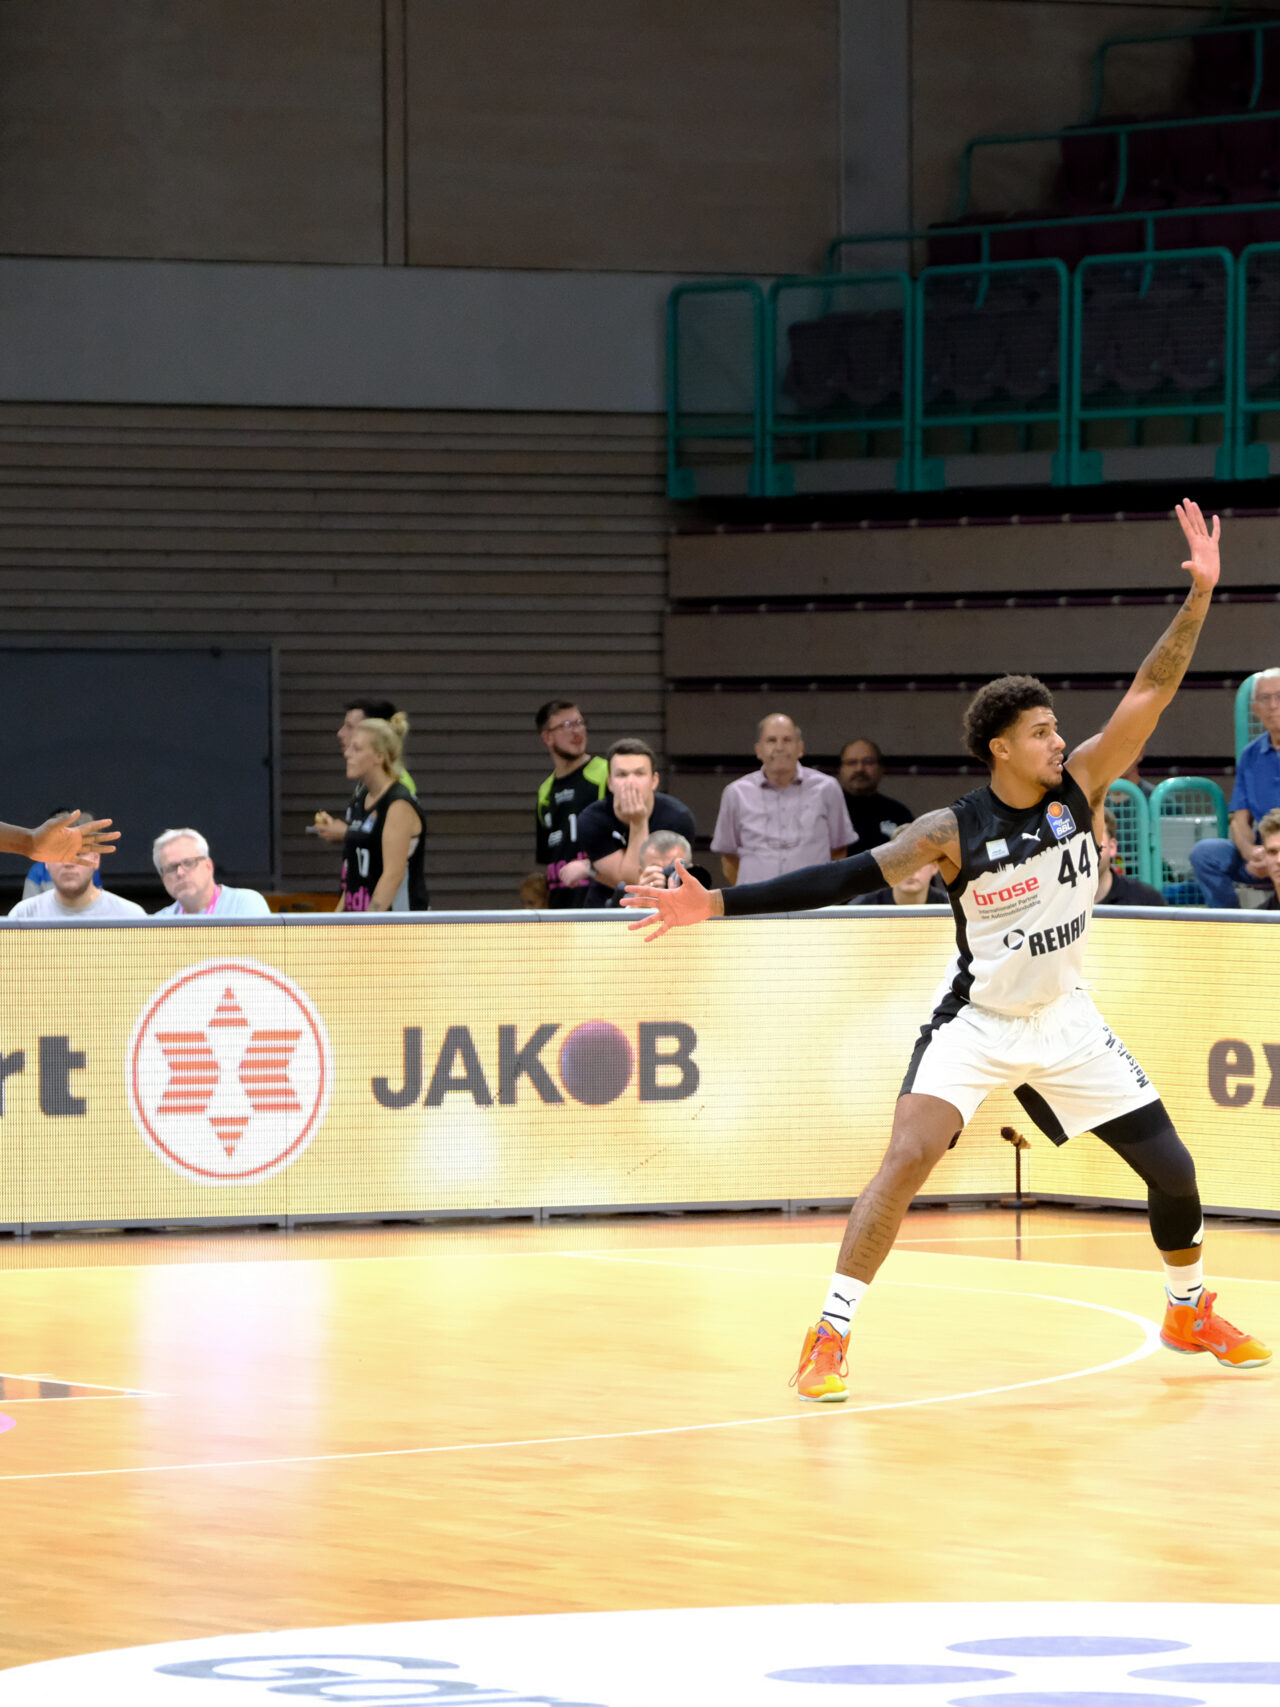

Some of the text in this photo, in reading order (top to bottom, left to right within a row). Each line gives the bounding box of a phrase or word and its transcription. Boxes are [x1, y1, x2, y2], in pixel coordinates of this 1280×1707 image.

[1057, 838, 1092, 889] 44
[972, 876, 1040, 906] brose
[1028, 909, 1087, 957] REHAU
[370, 1020, 700, 1107] JAKOB
